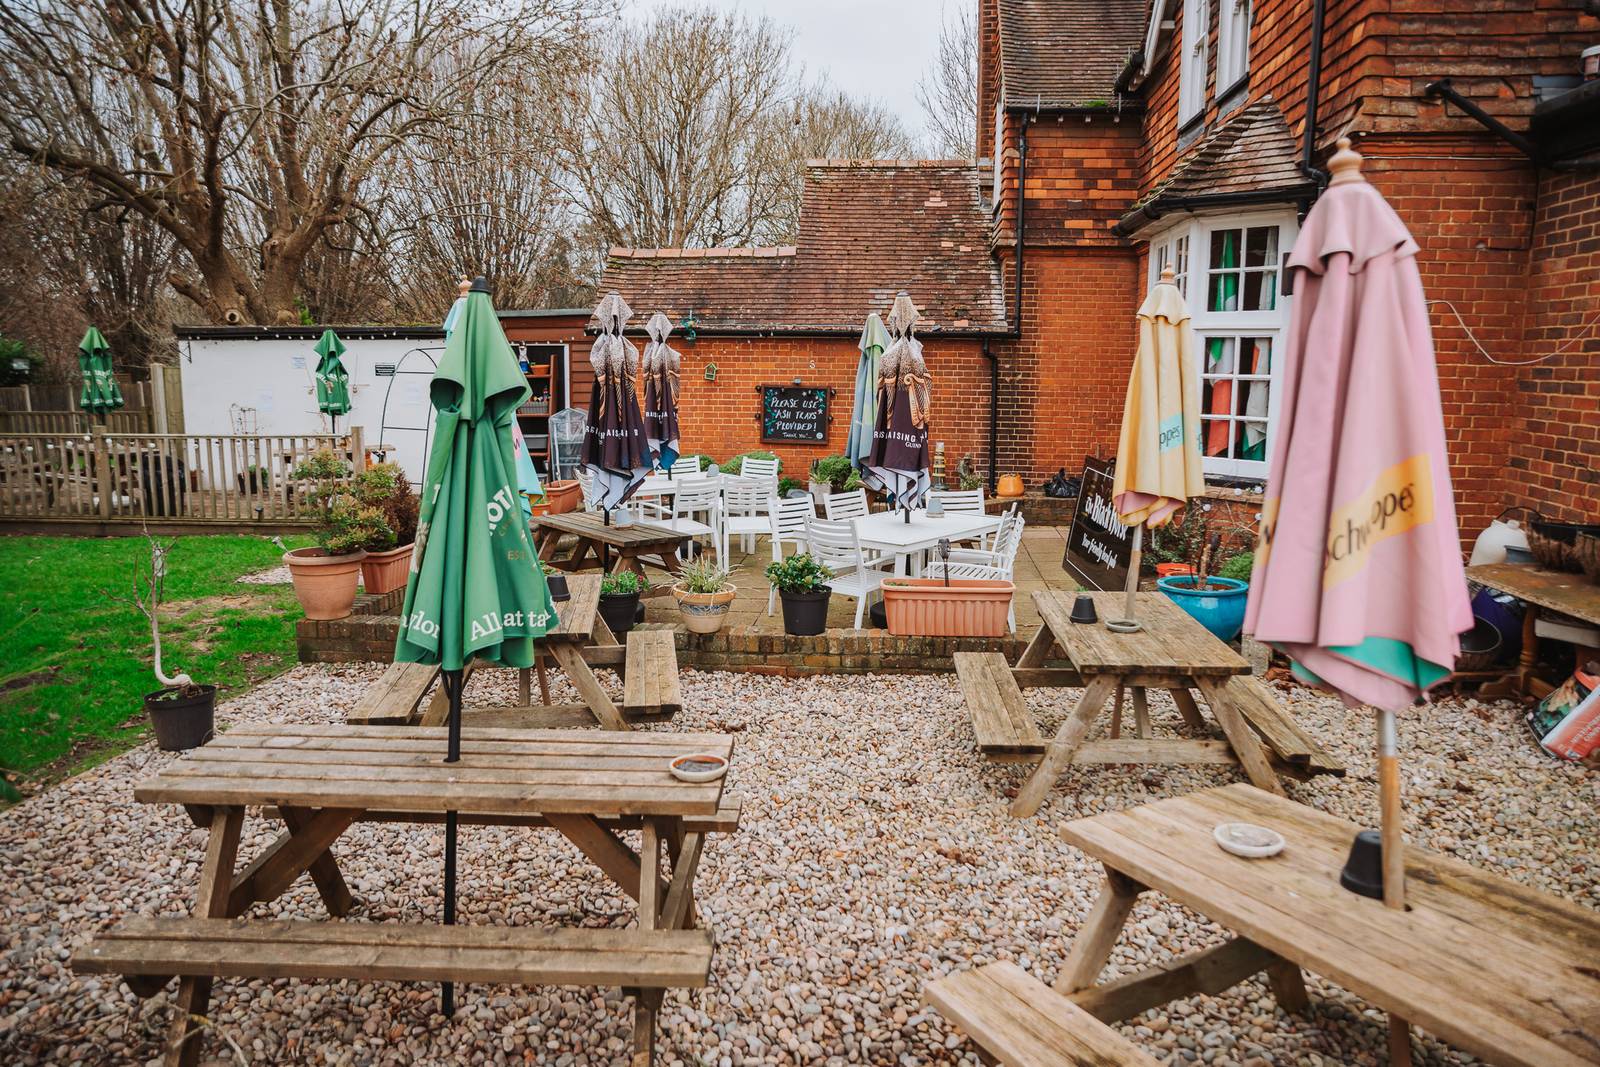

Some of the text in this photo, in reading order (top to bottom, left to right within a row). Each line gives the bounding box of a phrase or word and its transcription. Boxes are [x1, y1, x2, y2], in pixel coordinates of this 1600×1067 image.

[771, 396, 819, 409] PLEASE USE
[775, 409, 817, 420] ASH TRAYS
[775, 420, 817, 432] PROVIDED!
[471, 611, 503, 642] All
